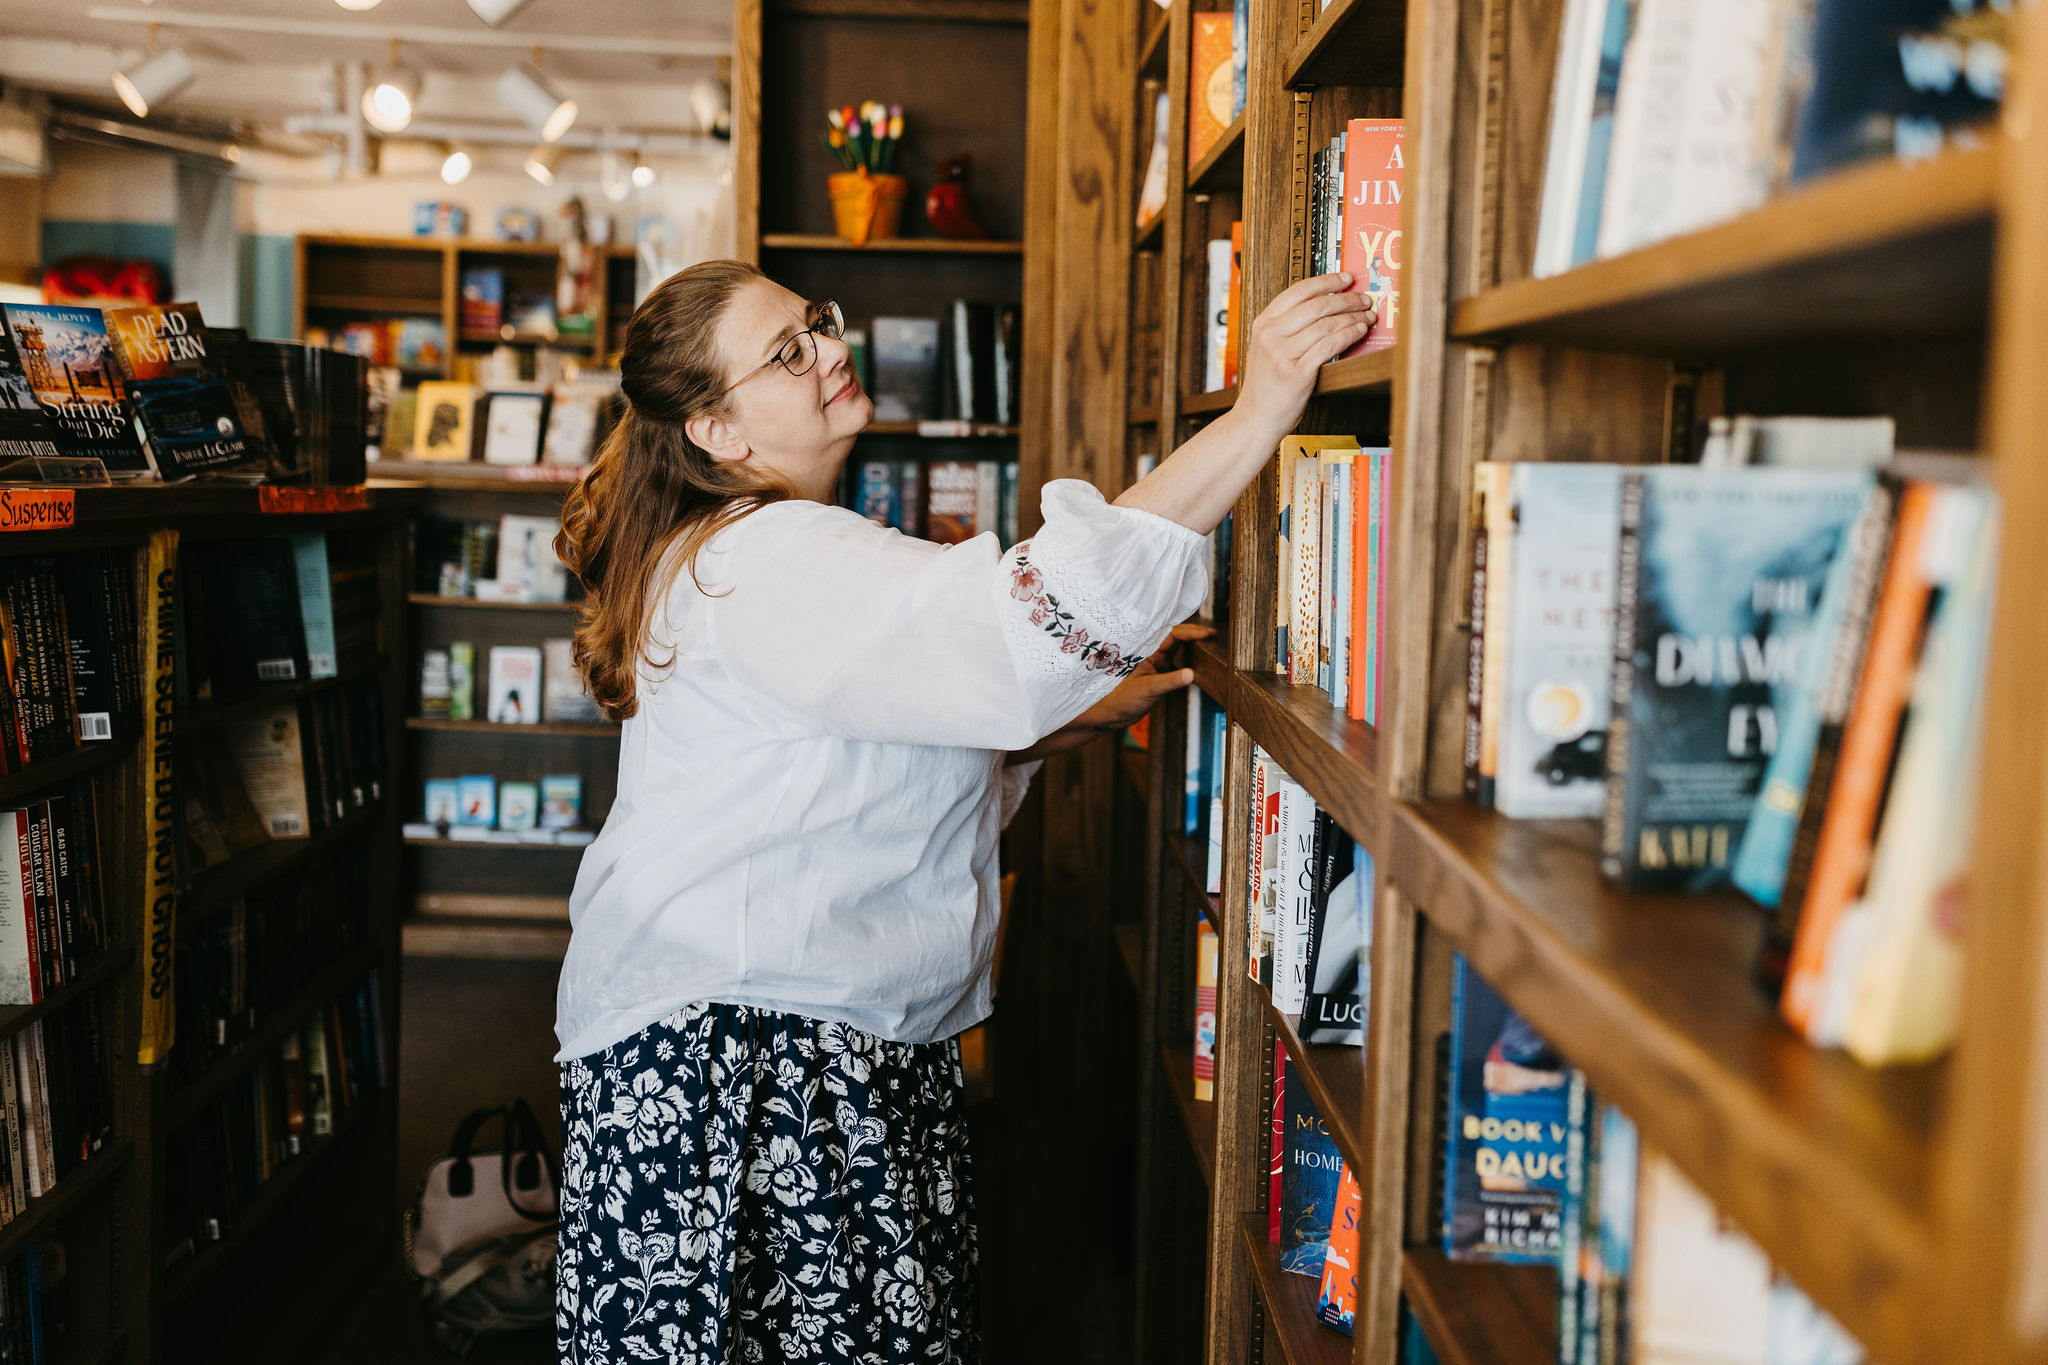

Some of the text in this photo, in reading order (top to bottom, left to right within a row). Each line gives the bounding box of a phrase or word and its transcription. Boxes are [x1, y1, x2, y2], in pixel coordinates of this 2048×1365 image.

[16, 310, 46, 320] DEAN
[57, 312, 91, 323] HOVEY
[132, 311, 188, 338] DEAD
[134, 334, 206, 363] ASTERN
[41, 394, 127, 427] Strung
[58, 419, 85, 430] Out
[86, 419, 121, 440] Die
[0, 440, 31, 456] ICHOLAS
[1, 492, 72, 529] Suspense
[21, 600, 34, 652] STOLEN
[28, 655, 40, 697] HOURS
[151, 567, 173, 1000] CRIME SCENE DO NOT CROSS
[40, 818, 50, 849] KILLING
[56, 827, 66, 849] DEAD
[1254, 769, 1264, 892] GILDED MOUNTAIN
[1281, 804, 1289, 845] MIRROR
[19, 833, 31, 866] WOLF
[30, 823, 42, 865] COUGAR
[43, 851, 54, 897] MONARCHS
[59, 851, 69, 877] CATCH
[1322, 855, 1334, 893] Lucidity
[22, 870, 34, 899] KILL
[34, 867, 45, 897] CLAW
[1463, 1114, 1542, 1144] BOOK
[1295, 1148, 1344, 1174] HOME
[1484, 1207, 1530, 1228] KIM
